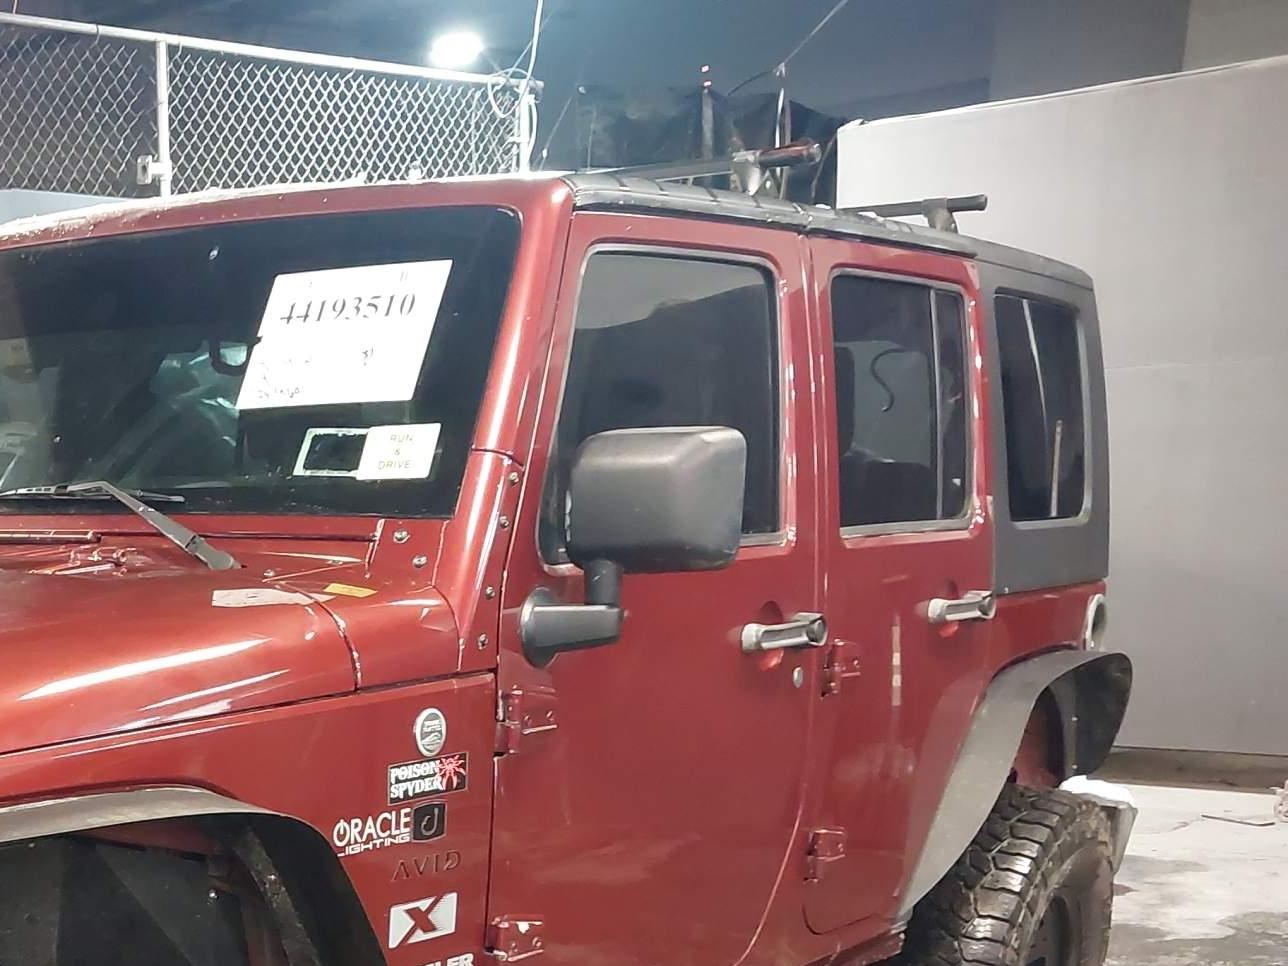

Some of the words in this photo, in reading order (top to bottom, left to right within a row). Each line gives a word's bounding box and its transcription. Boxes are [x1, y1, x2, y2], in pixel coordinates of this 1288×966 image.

[280, 294, 416, 325] 44193510
[377, 460, 412, 470] DRIVE
[390, 759, 441, 785] POISON
[390, 776, 444, 799] SPYDER
[333, 808, 412, 847] ORACLE
